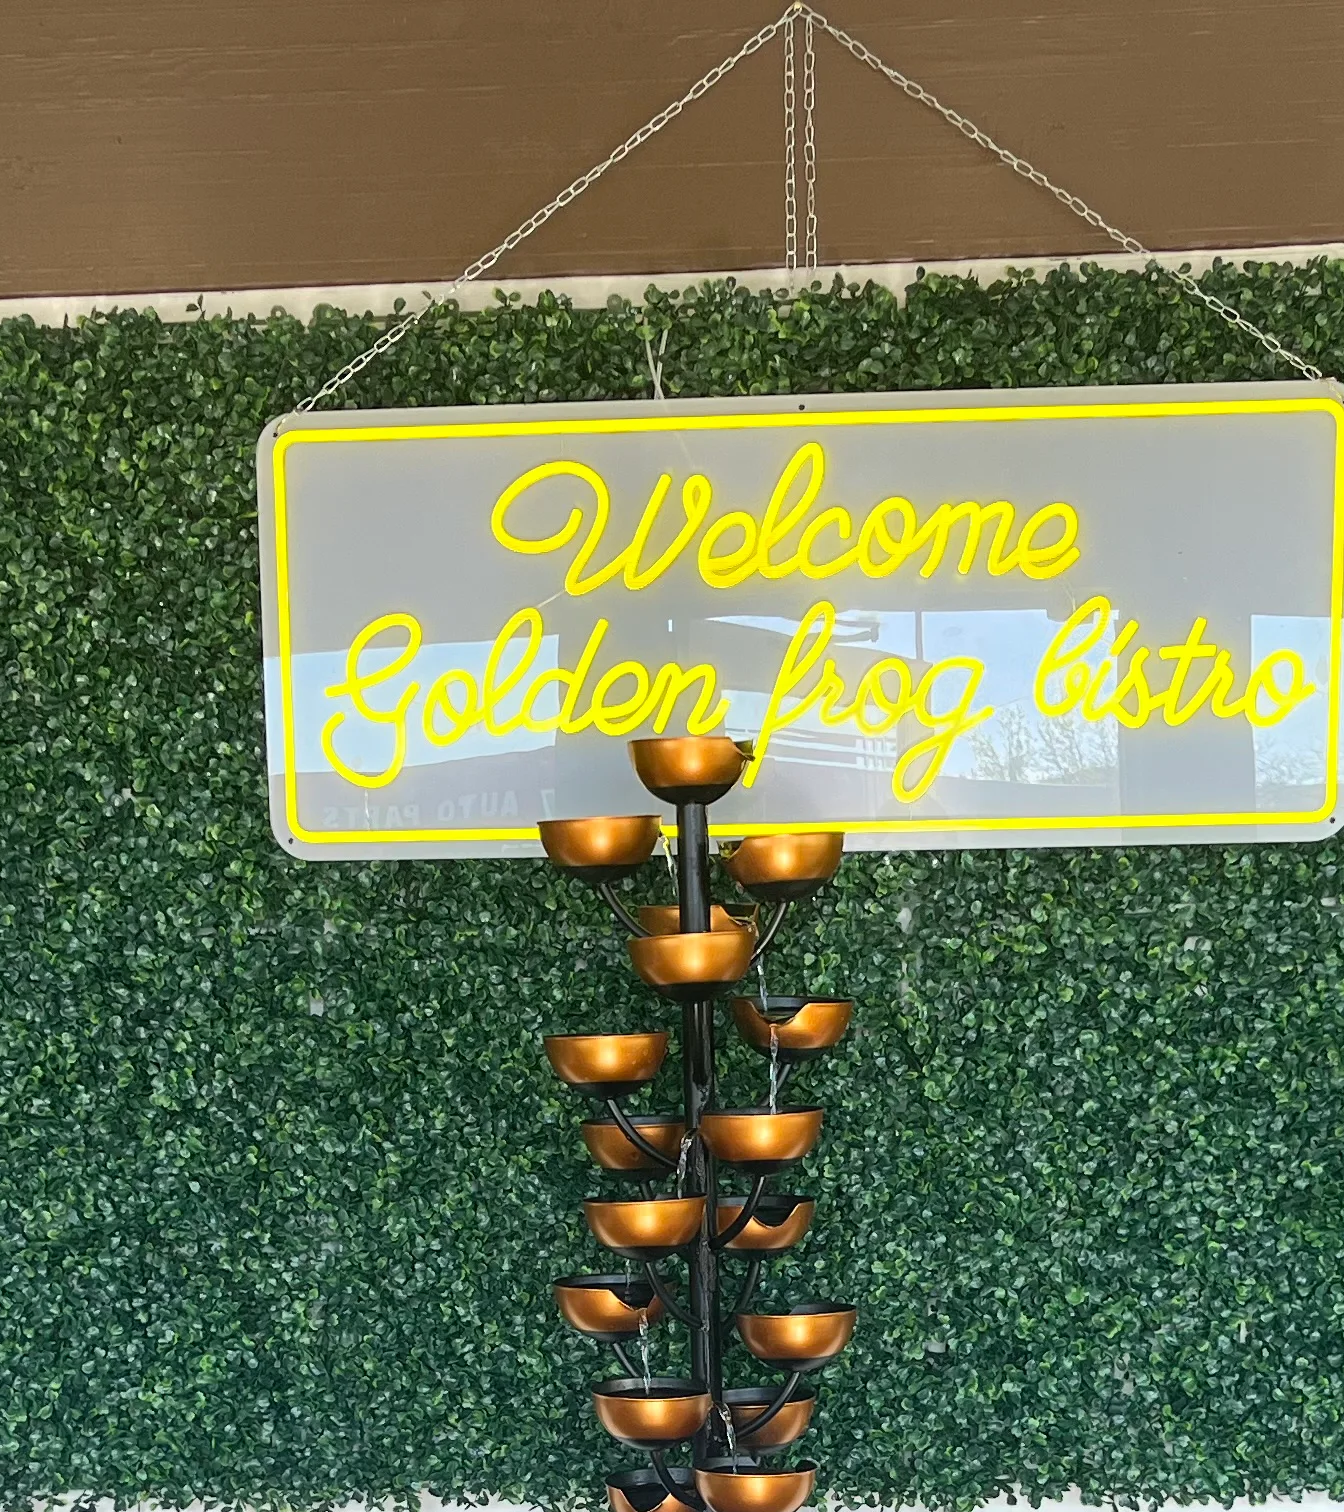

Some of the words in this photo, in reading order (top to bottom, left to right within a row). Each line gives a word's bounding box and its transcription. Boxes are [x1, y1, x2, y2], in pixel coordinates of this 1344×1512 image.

[488, 440, 1084, 598] Welcome
[320, 605, 732, 790] Golden
[740, 599, 996, 804] frog
[1032, 594, 1319, 730] bistro
